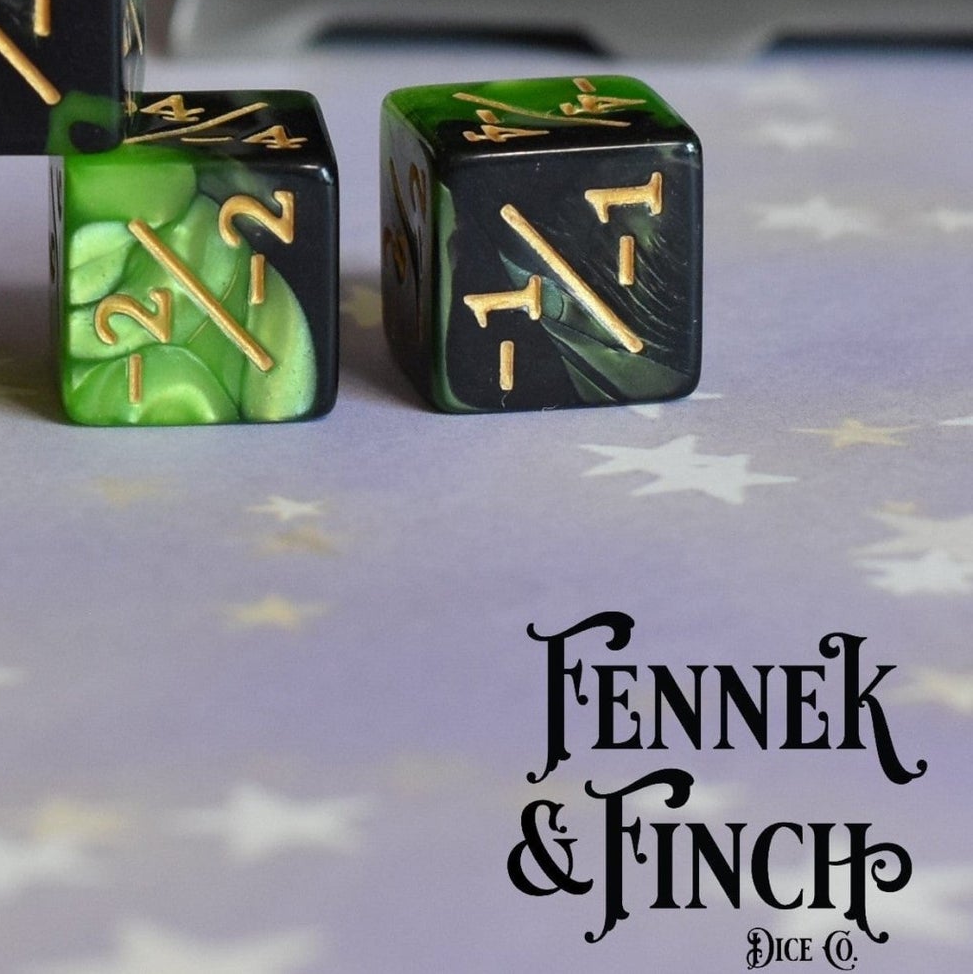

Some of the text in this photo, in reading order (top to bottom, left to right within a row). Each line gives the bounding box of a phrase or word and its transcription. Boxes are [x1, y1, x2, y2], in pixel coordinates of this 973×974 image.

[94, 288, 172, 404] -2
[218, 190, 294, 304] -2
[463, 274, 542, 391] -1
[584, 171, 663, 286] -1
